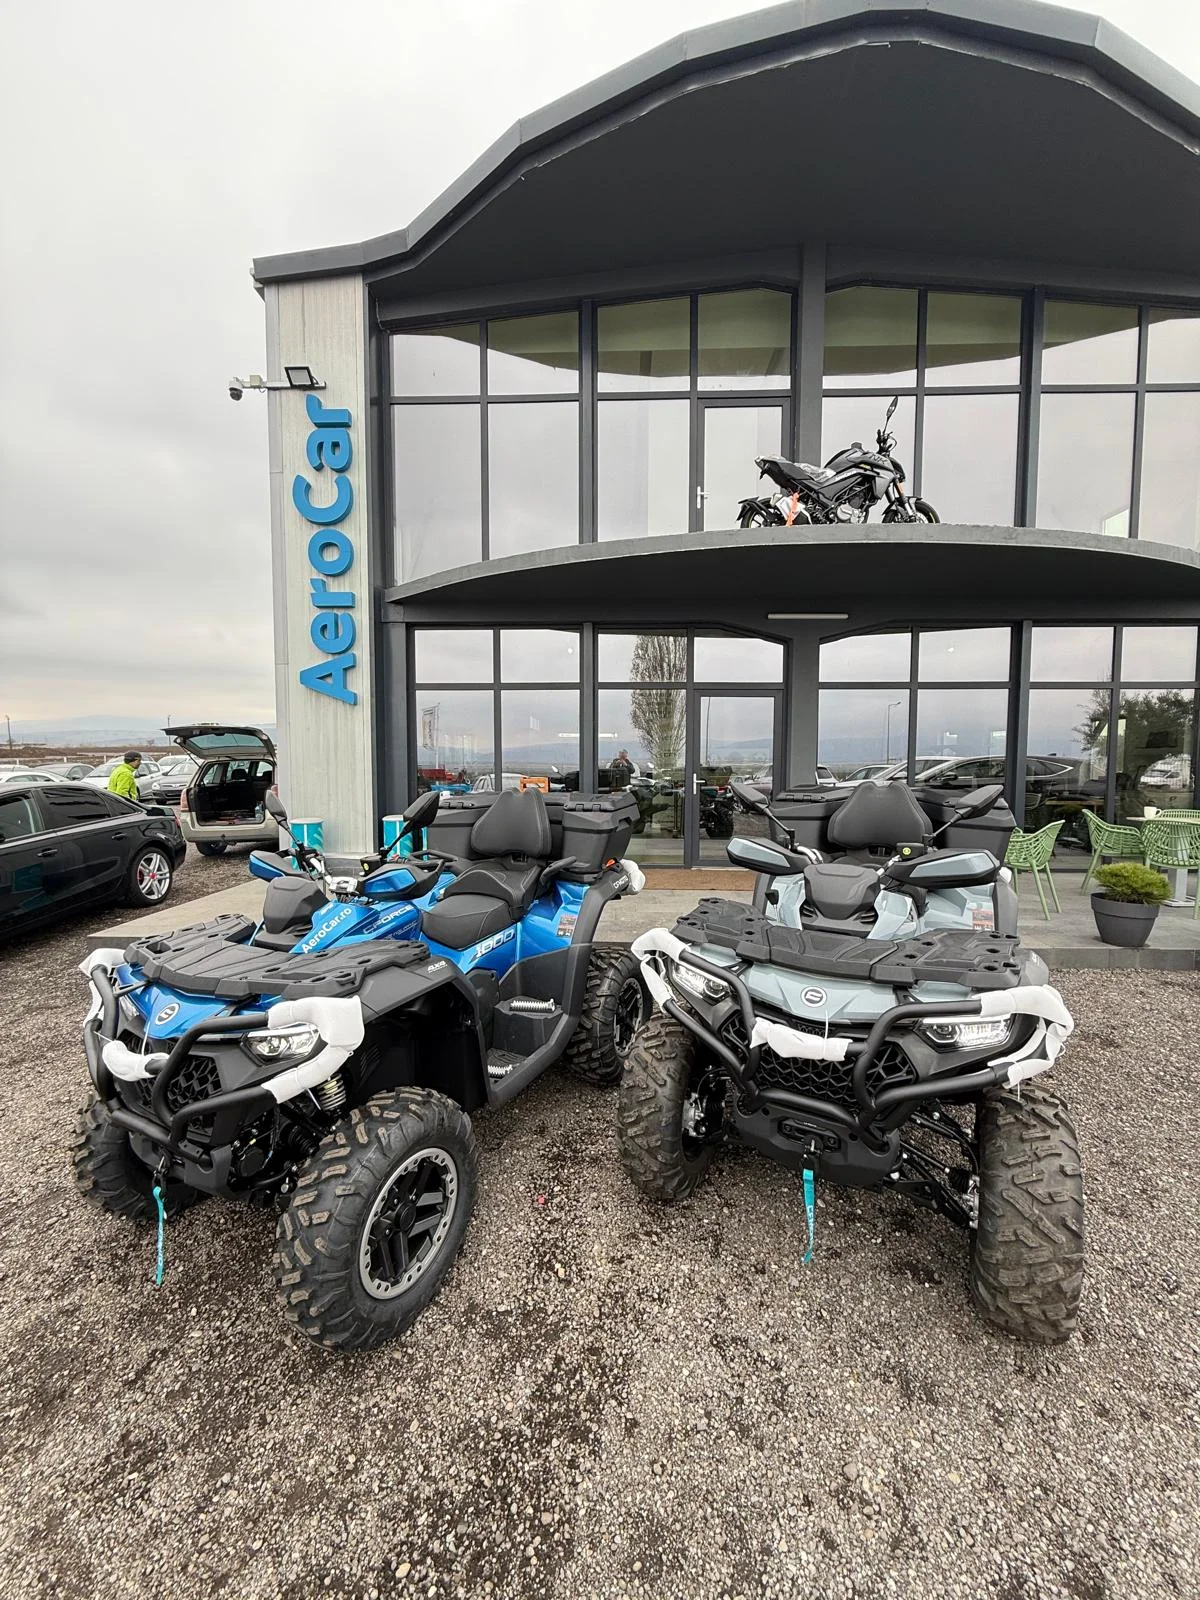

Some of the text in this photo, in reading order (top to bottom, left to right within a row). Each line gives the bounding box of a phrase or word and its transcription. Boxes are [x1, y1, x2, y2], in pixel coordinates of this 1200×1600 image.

[292, 394, 358, 705] AeroCar
[301, 907, 353, 954] AeroCar.ro
[363, 904, 415, 934] CFORCE
[475, 929, 516, 958] 1000
